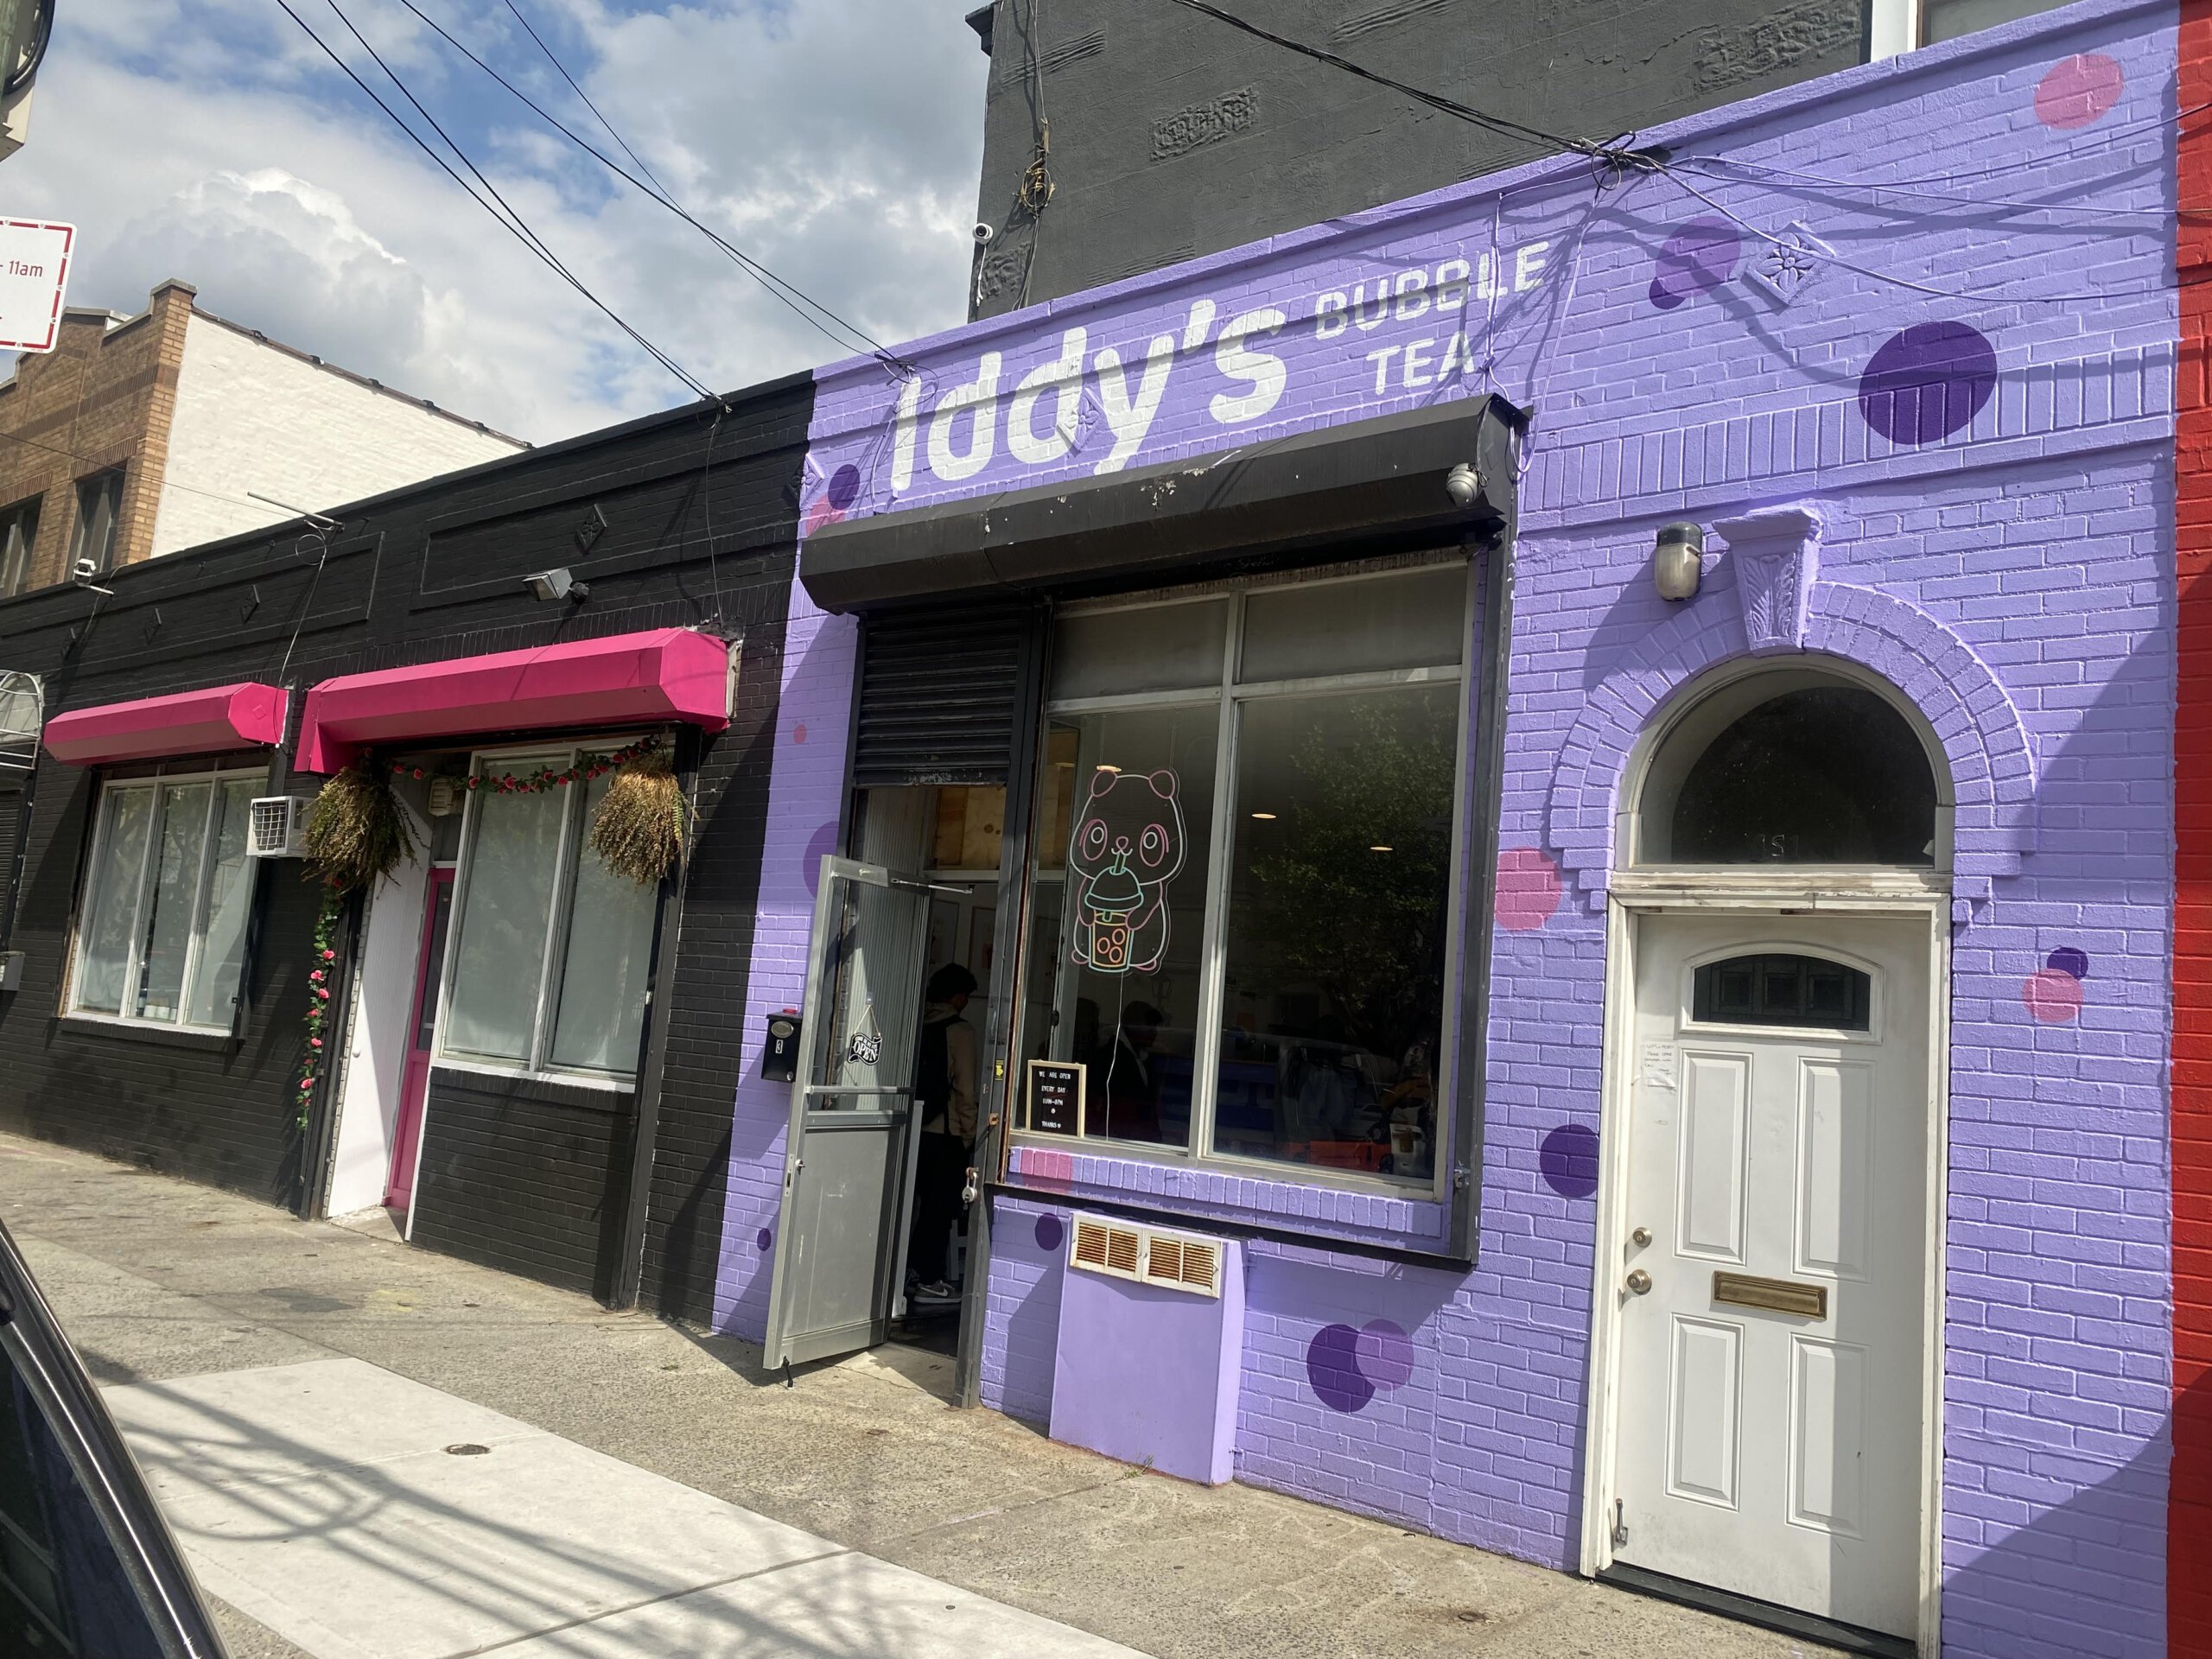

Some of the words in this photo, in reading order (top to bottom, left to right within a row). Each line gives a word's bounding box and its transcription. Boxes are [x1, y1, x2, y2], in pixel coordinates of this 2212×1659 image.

[9, 260, 43, 277] 11am
[1315, 241, 1549, 340] BUBBLE
[890, 299, 1287, 491] Iddy's
[1366, 330, 1475, 395] TEA
[854, 1040, 876, 1061] OPEN
